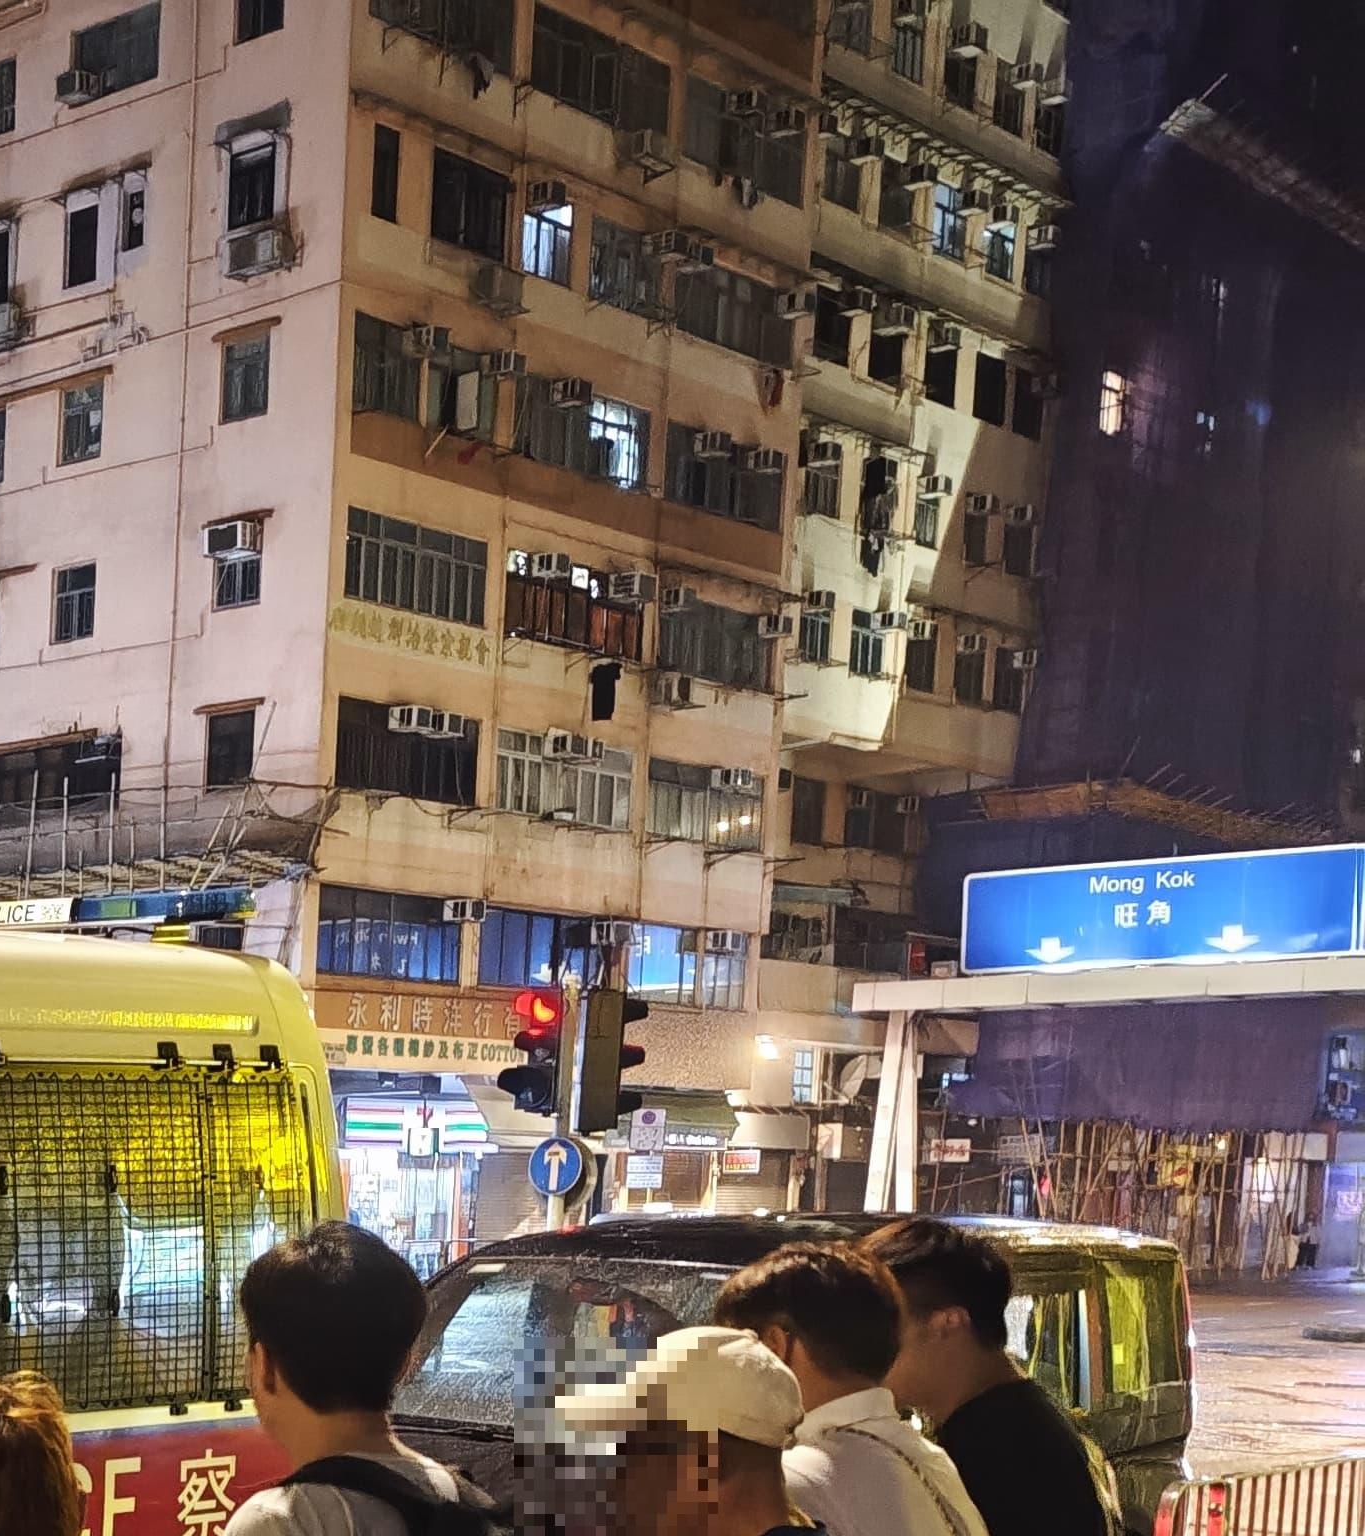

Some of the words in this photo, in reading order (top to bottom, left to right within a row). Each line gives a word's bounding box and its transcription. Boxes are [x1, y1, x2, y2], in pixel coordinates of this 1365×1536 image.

[1089, 875, 1144, 895] Mong
[1156, 870, 1195, 889] Kok
[1114, 900, 1171, 928] 旺角
